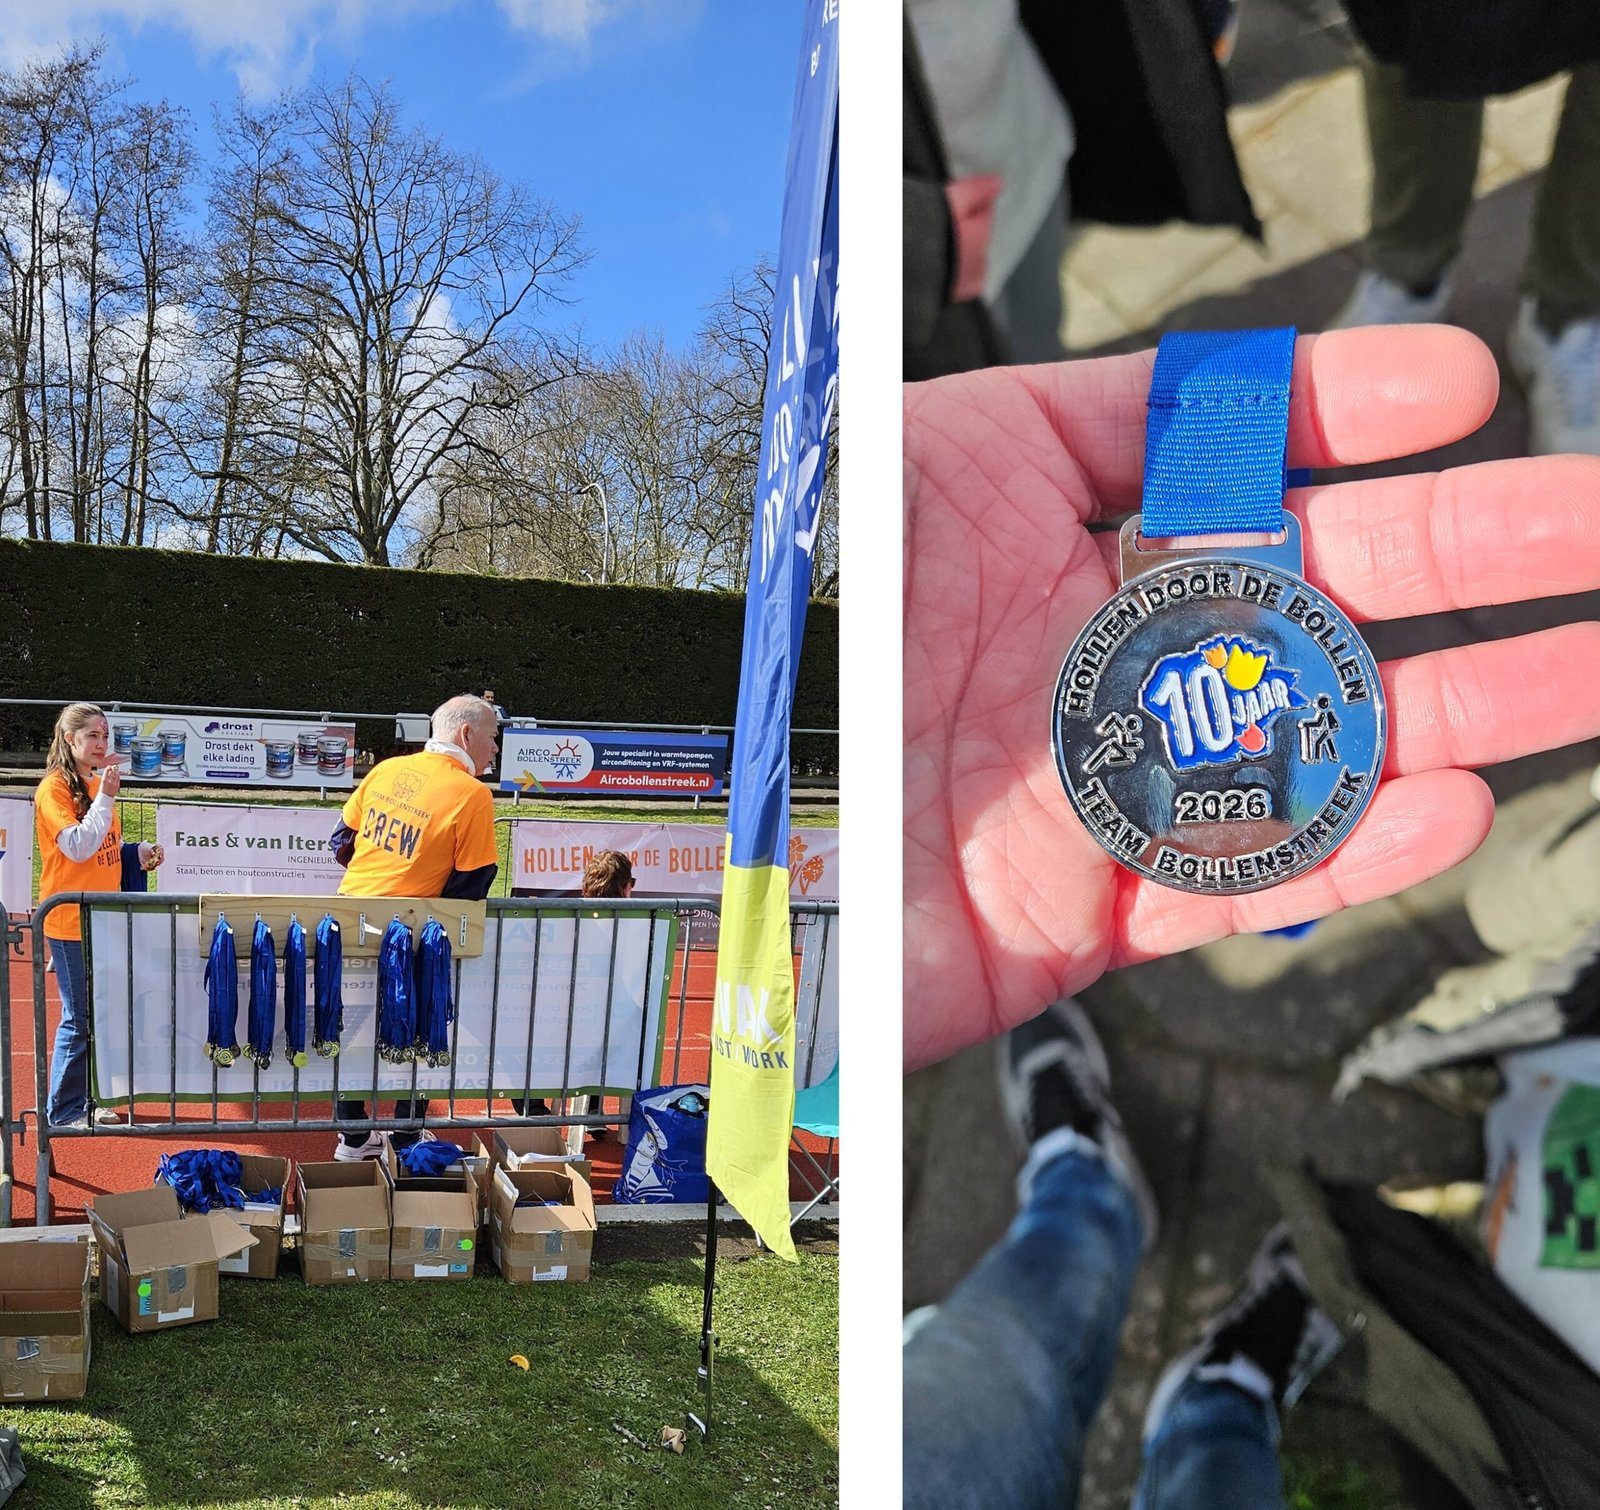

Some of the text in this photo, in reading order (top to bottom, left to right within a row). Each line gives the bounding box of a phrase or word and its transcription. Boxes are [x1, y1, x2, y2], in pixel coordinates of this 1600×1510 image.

[1065, 571, 1369, 716] HOLLEN DOOR DE BOLLEN
[1151, 664, 1293, 756] 10 JAAR
[221, 722, 254, 731] drost
[205, 740, 254, 752] Drost dekt
[518, 748, 550, 757] AIRCO
[203, 752, 255, 766] elke lading
[517, 755, 582, 764] BOLLENSTREEK
[602, 749, 620, 757] Jouw
[621, 750, 653, 759] specialist
[660, 751, 715, 761] warmtepompen,
[601, 758, 651, 768] airconditioning
[662, 760, 710, 769] VRF-systemen
[600, 774, 710, 787] Aircobollenstreek.nl
[385, 796, 431, 820] BOLLENSTREEK
[1176, 789, 1271, 823] 2026
[1077, 766, 1367, 882] TEAM BOLLENSTREEK
[175, 831, 219, 848] Faas
[225, 832, 239, 848] &
[245, 836, 282, 850] van
[363, 807, 422, 860] CREW
[523, 845, 594, 874] HOLLEN
[644, 849, 661, 867] DE
[176, 866, 198, 876] Staal,
[200, 867, 224, 876] beton
[237, 868, 306, 879] houtconstructies
[742, 1044, 789, 1069] WORK
